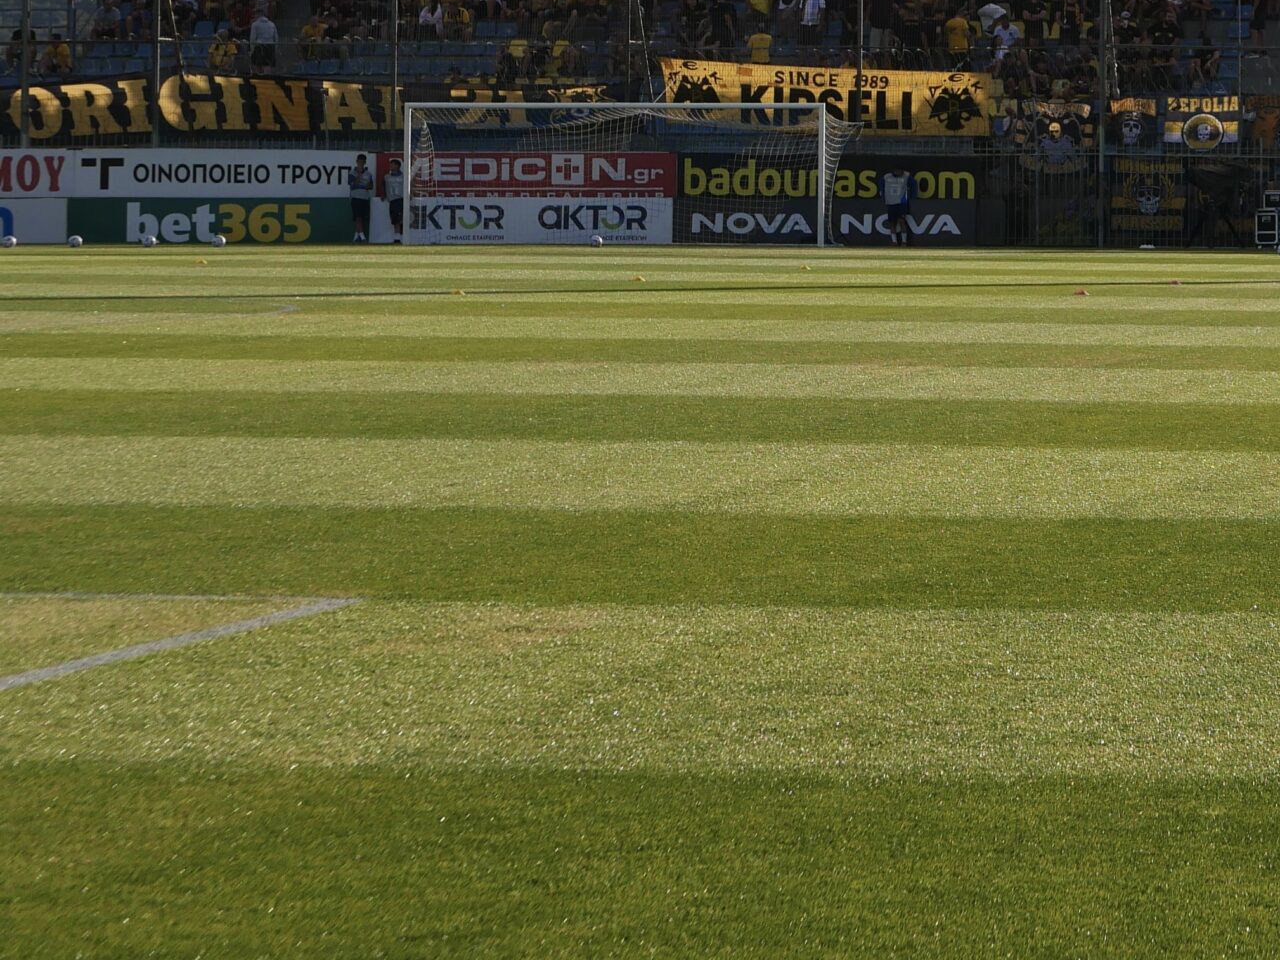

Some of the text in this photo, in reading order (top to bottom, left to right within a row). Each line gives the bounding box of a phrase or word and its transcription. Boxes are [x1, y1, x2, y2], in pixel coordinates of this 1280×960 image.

[774, 70, 889, 90] SINCE 1989
[6, 74, 404, 139] ORIGINAL
[740, 83, 913, 130] KIPSELI
[132, 162, 353, 185] ΟΙΝΟΠΟΙΕΙΟ ΤΡΟΥΠ
[126, 201, 311, 242] bet365
[691, 213, 813, 235] NOVA
